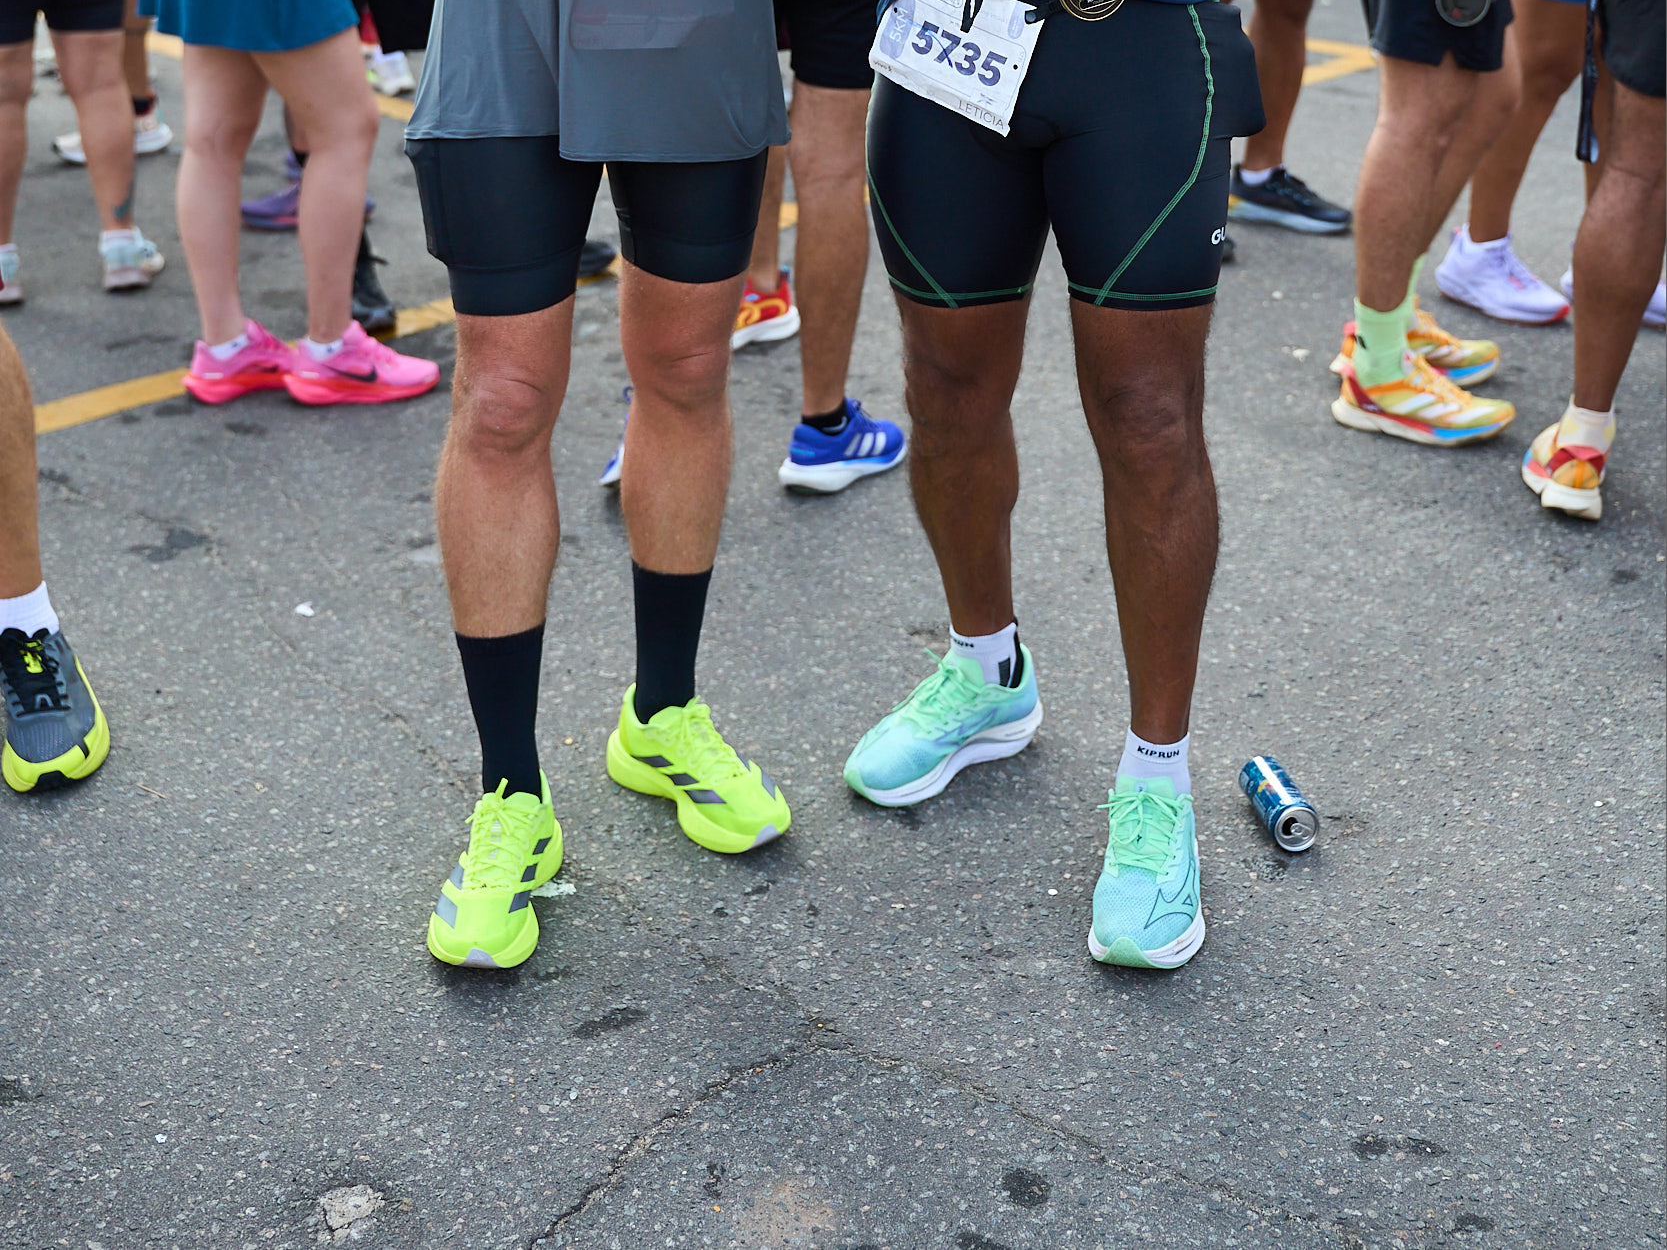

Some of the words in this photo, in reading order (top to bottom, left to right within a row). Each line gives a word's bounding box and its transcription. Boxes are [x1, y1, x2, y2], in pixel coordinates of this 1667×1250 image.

[889, 8, 909, 42] 5KM
[912, 20, 1008, 87] 5735
[959, 100, 1004, 130] LETICIA
[1136, 745, 1180, 759] KIPRUN
